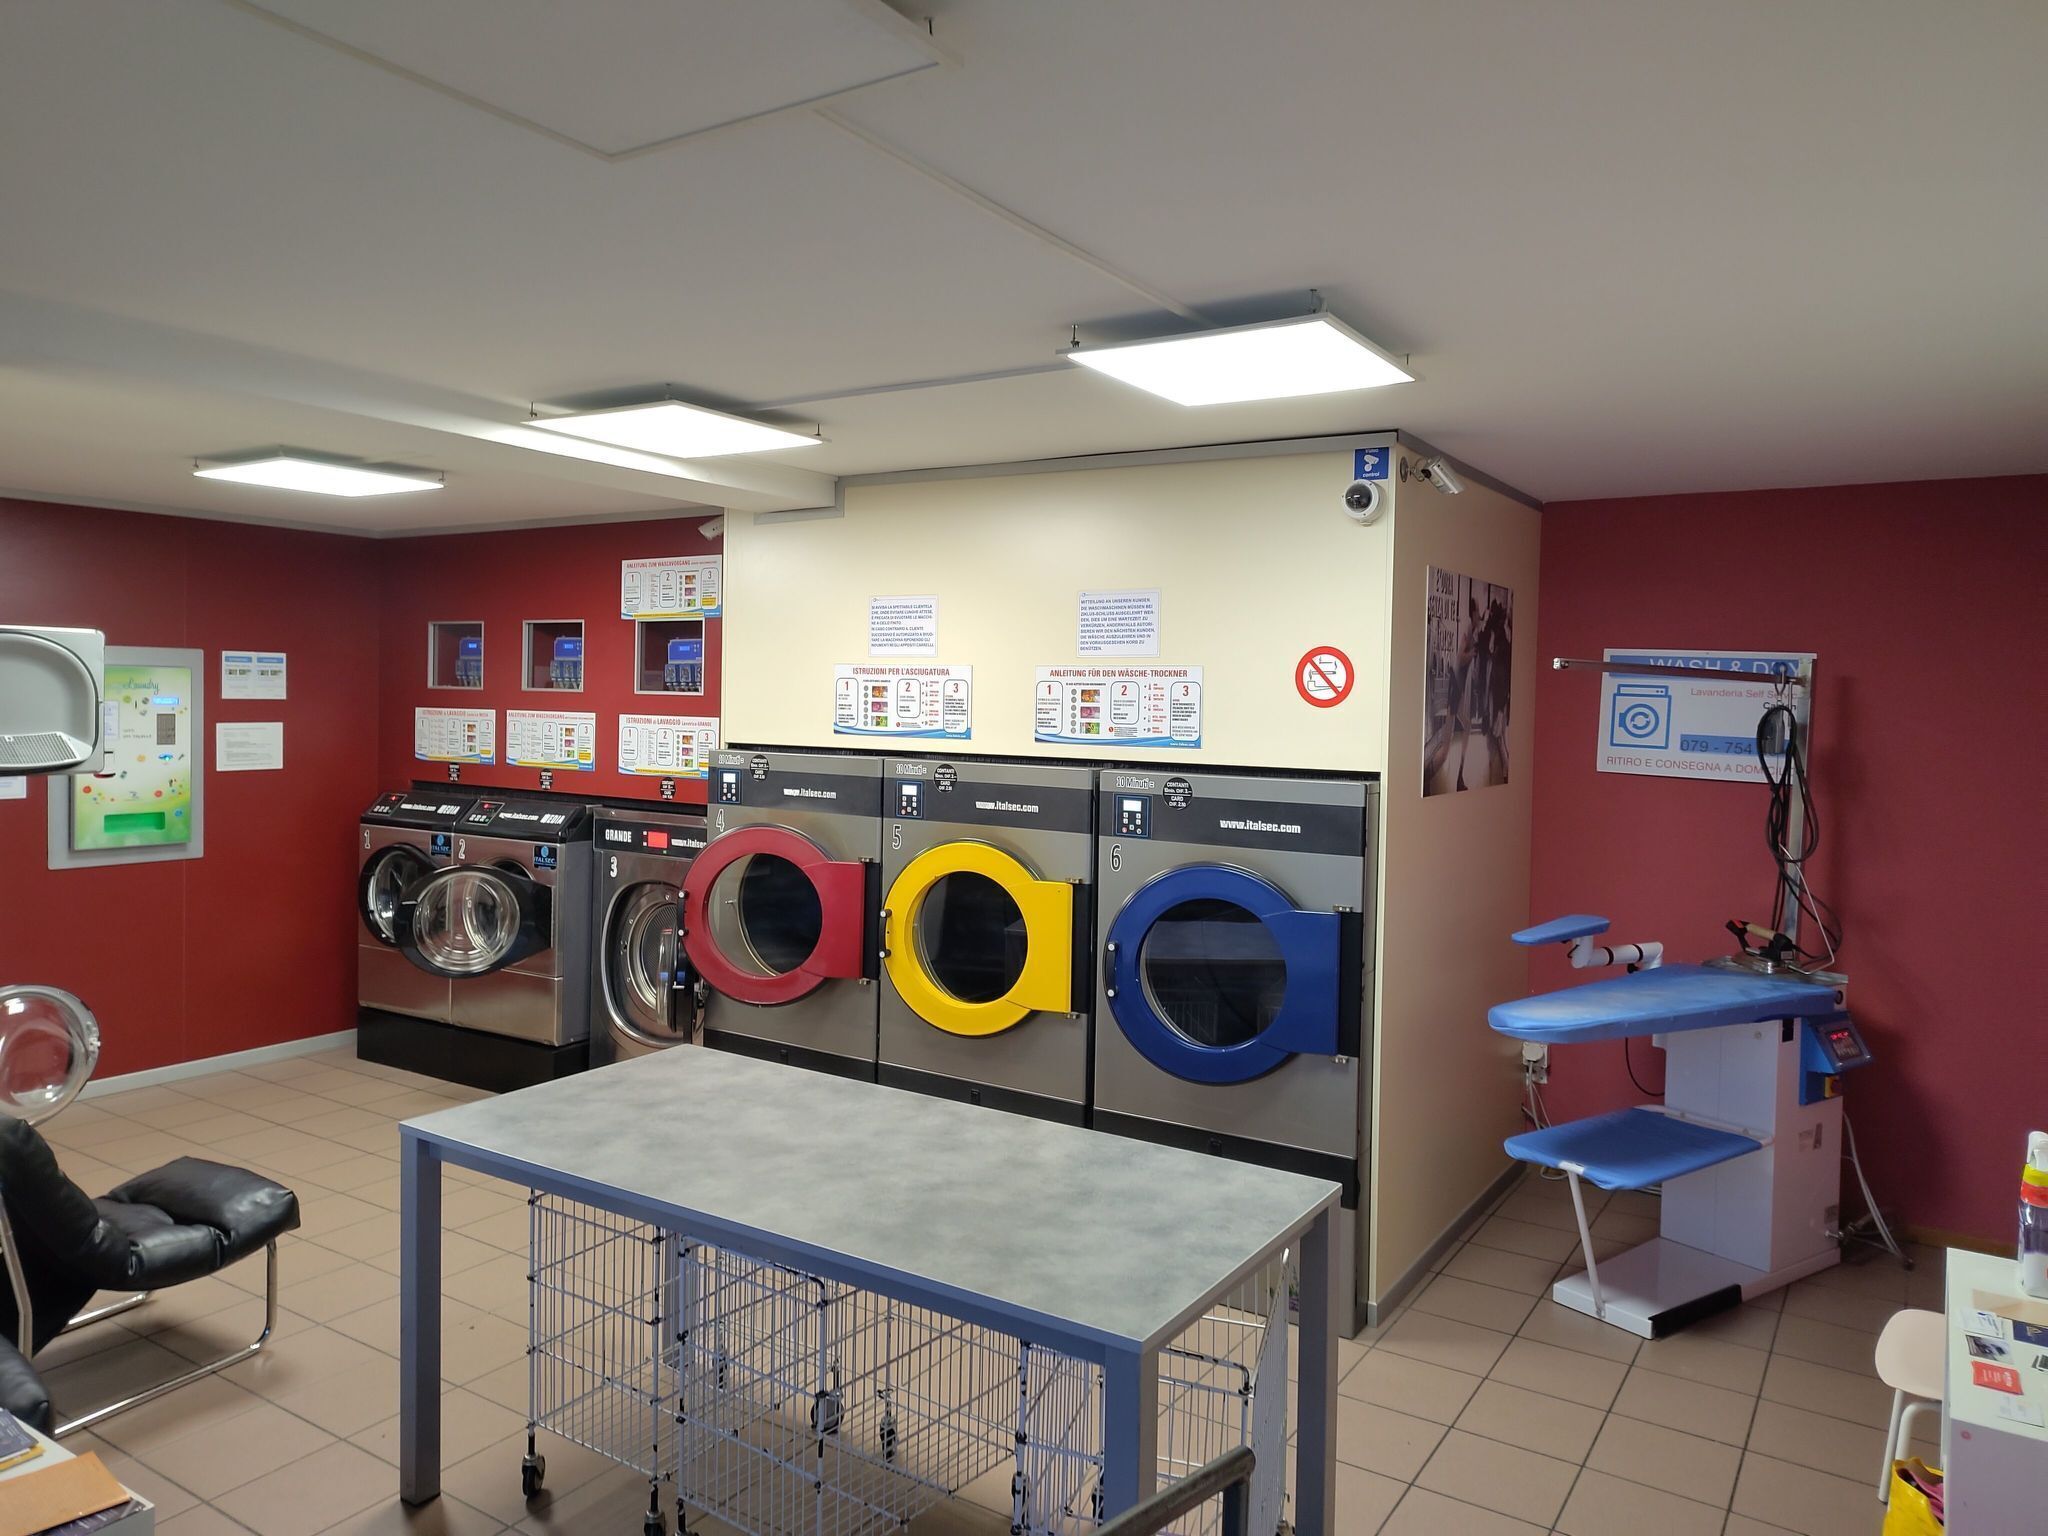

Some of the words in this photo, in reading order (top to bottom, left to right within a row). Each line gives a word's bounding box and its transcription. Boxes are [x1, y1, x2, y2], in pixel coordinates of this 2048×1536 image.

[631, 574, 634, 583] 1
[666, 573, 670, 581] 2
[707, 570, 712, 580] 3
[852, 667, 887, 675] ISTRUZIONI
[901, 668, 950, 676] L'ASCIUGATURA
[1049, 669, 1086, 678] ANLEITUNG
[1087, 668, 1101, 678] FÜR
[1102, 670, 1116, 678] DEN
[1117, 668, 1188, 678] WÄSCHE-TROCKNER
[1752, 661, 1800, 676] DY
[844, 681, 849, 691] 1
[905, 682, 911, 692] 2
[953, 683, 959, 693] 3
[1047, 684, 1051, 695] 1
[1121, 685, 1127, 696] 2
[1182, 685, 1189, 697] 3
[1690, 688, 1743, 697] Lavanderia
[1745, 689, 1764, 698] Self
[452, 721, 455, 729] 2
[486, 722, 490, 730] 3
[513, 723, 516, 731] 1
[548, 724, 552, 733] 2
[584, 726, 588, 734] 3
[628, 729, 632, 737] 1
[663, 731, 667, 739] 2
[704, 733, 709, 741] 3
[1680, 739, 1708, 752] 079
[1726, 741, 1752, 755] 754
[896, 764, 904, 774] 10
[904, 764, 923, 775] Minuti
[1606, 756, 1642, 767] RITIRO
[1645, 758, 1651, 767] E
[1655, 759, 1721, 772] CONSEGNA
[1724, 764, 1732, 772] A
[1116, 776, 1125, 787] 10
[1126, 776, 1149, 789] Minuti
[783, 788, 837, 799] www.italsec.com
[975, 801, 1039, 813] www.italsec.com
[540, 814, 565, 824] MEDIA
[716, 808, 725, 832] 4
[1219, 819, 1301, 834] www.italsec.com
[364, 829, 371, 849] 1
[605, 829, 632, 843] GRANDE
[892, 824, 902, 849] 5
[458, 839, 466, 860] 2
[1110, 843, 1122, 872] 6
[609, 856, 618, 878] 3
